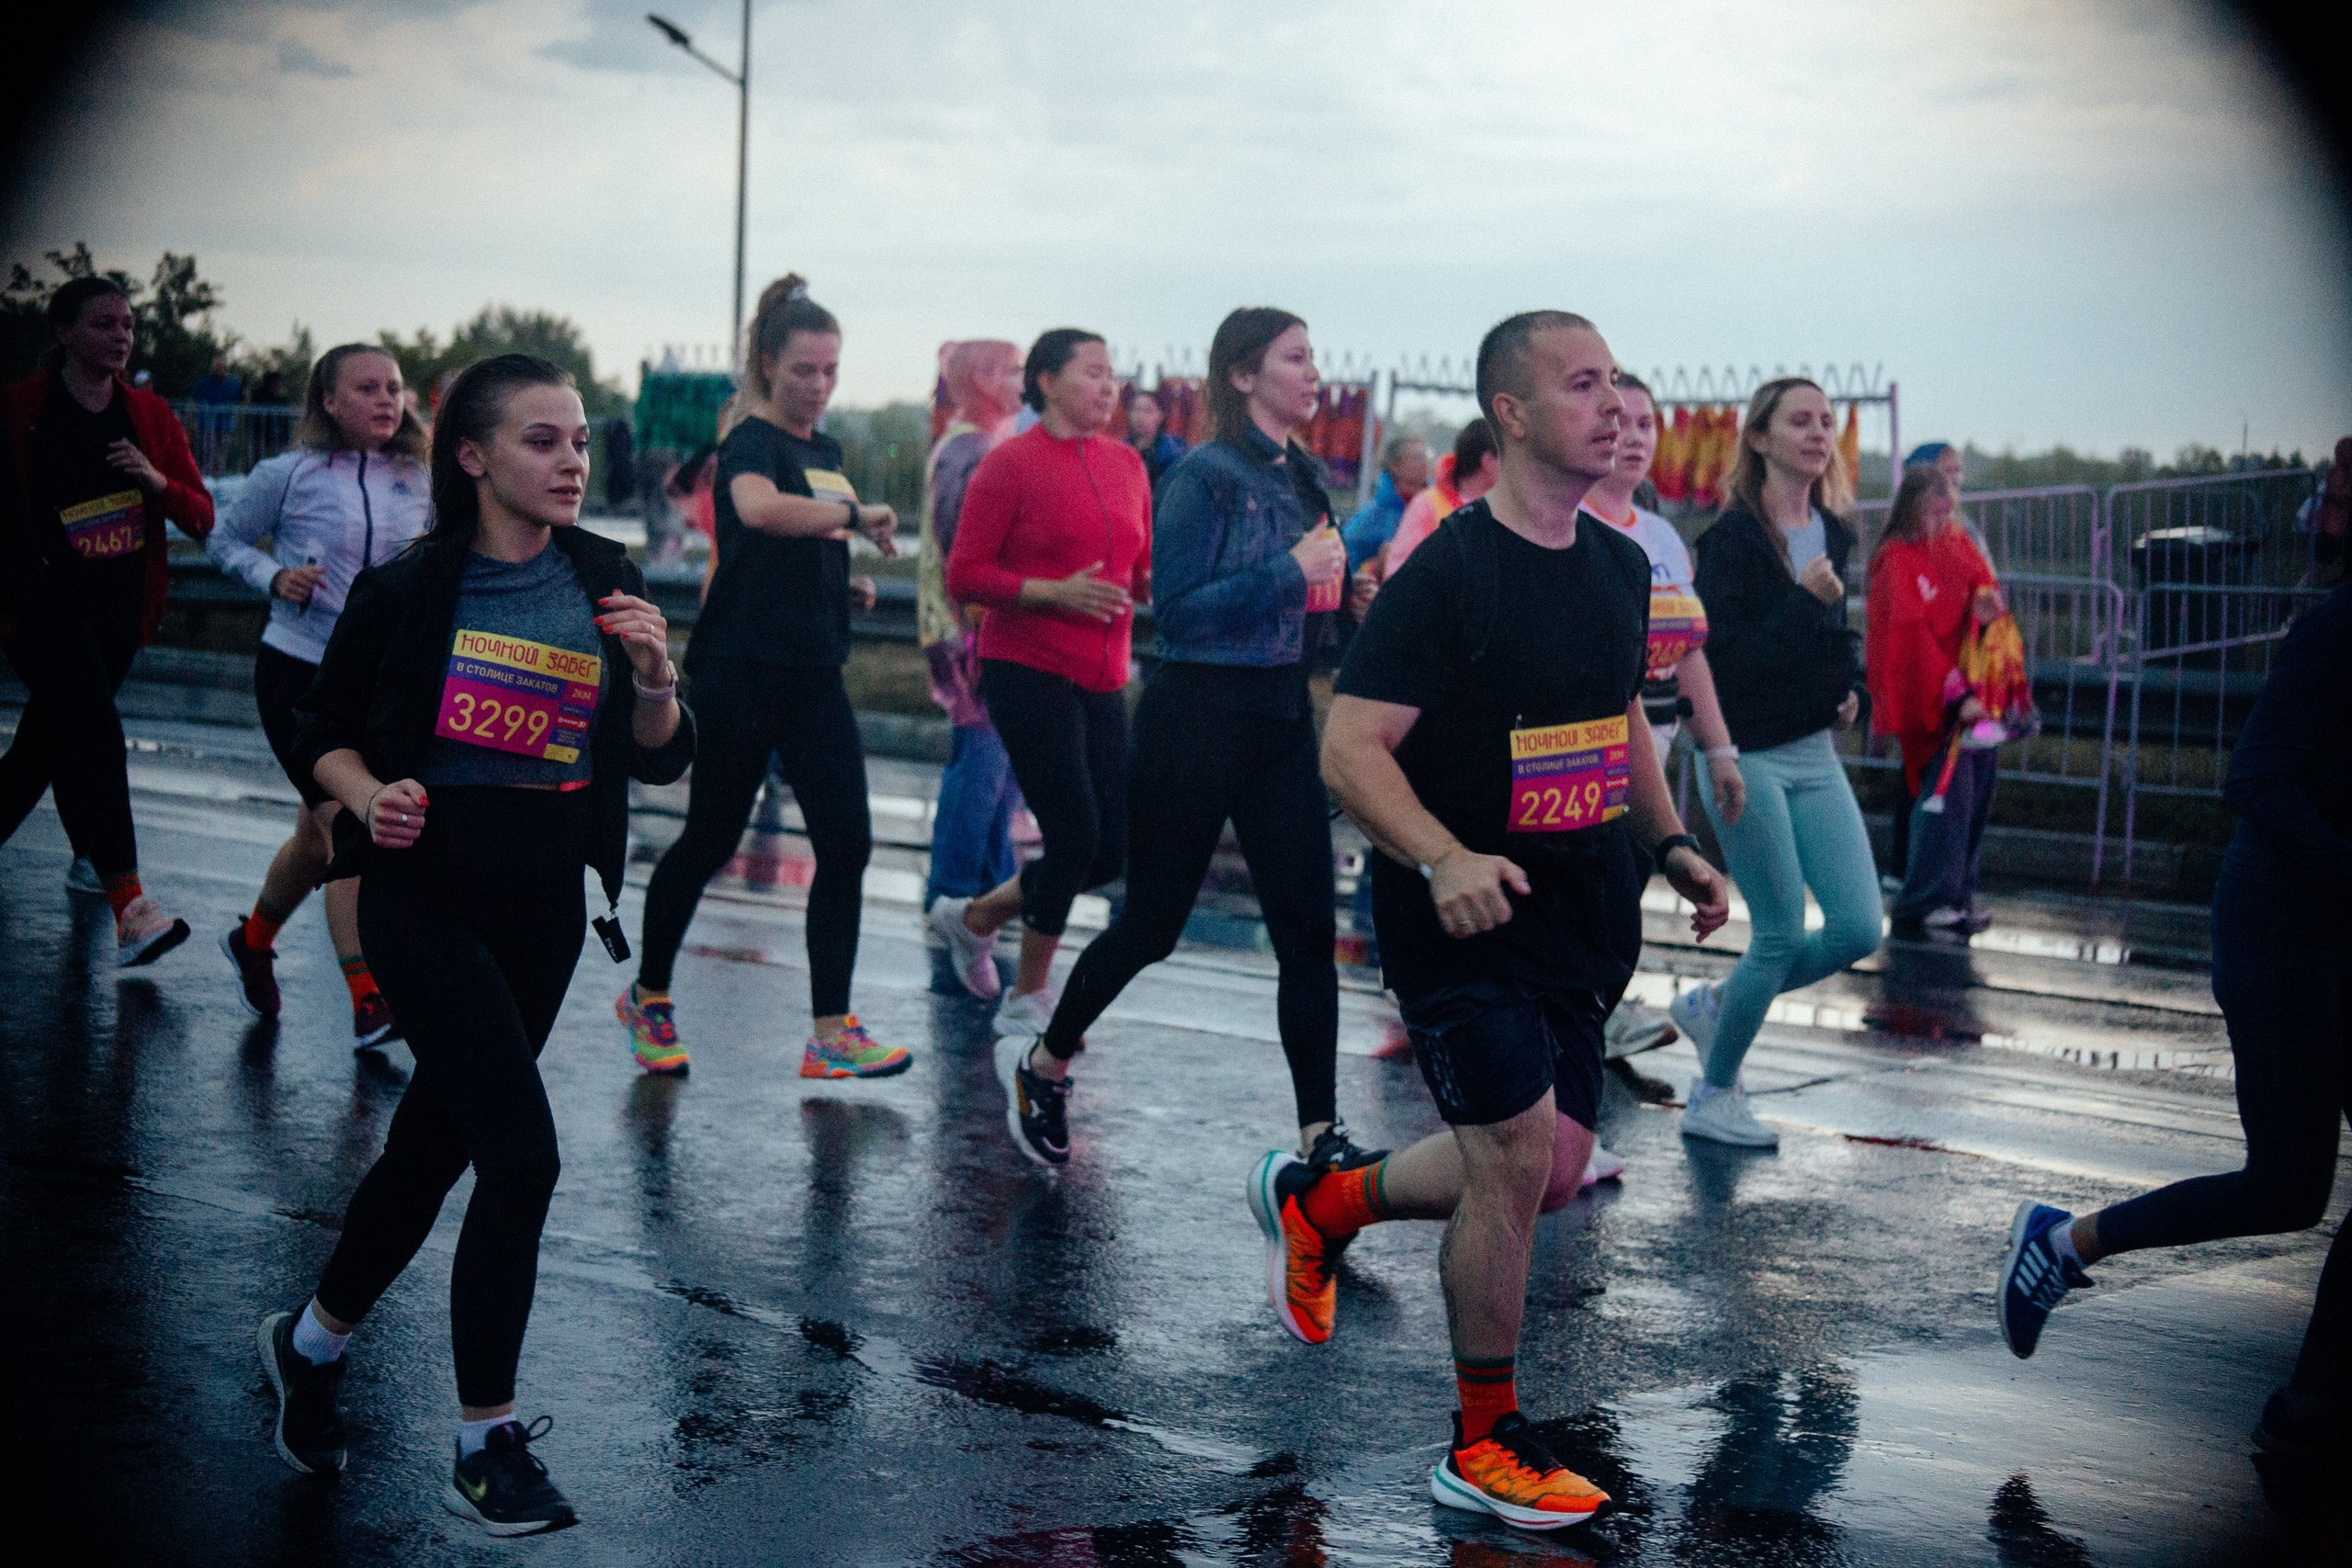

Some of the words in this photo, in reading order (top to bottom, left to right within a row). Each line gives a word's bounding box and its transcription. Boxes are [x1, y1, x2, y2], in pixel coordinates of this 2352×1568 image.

[78, 525, 132, 558] 2467
[460, 636, 540, 666] НОЧНОЙ
[546, 651, 598, 678] ЗАБЕГ
[456, 662, 465, 671] В
[466, 664, 515, 683] СТОЛИЦЕ
[516, 674, 559, 694] ЗАКАТОВ
[448, 694, 549, 746] 3299
[1516, 729, 1578, 752] НОЧНОЙ
[1585, 720, 1624, 745] ЗАБЕГ
[1519, 782, 1600, 825] 2249
